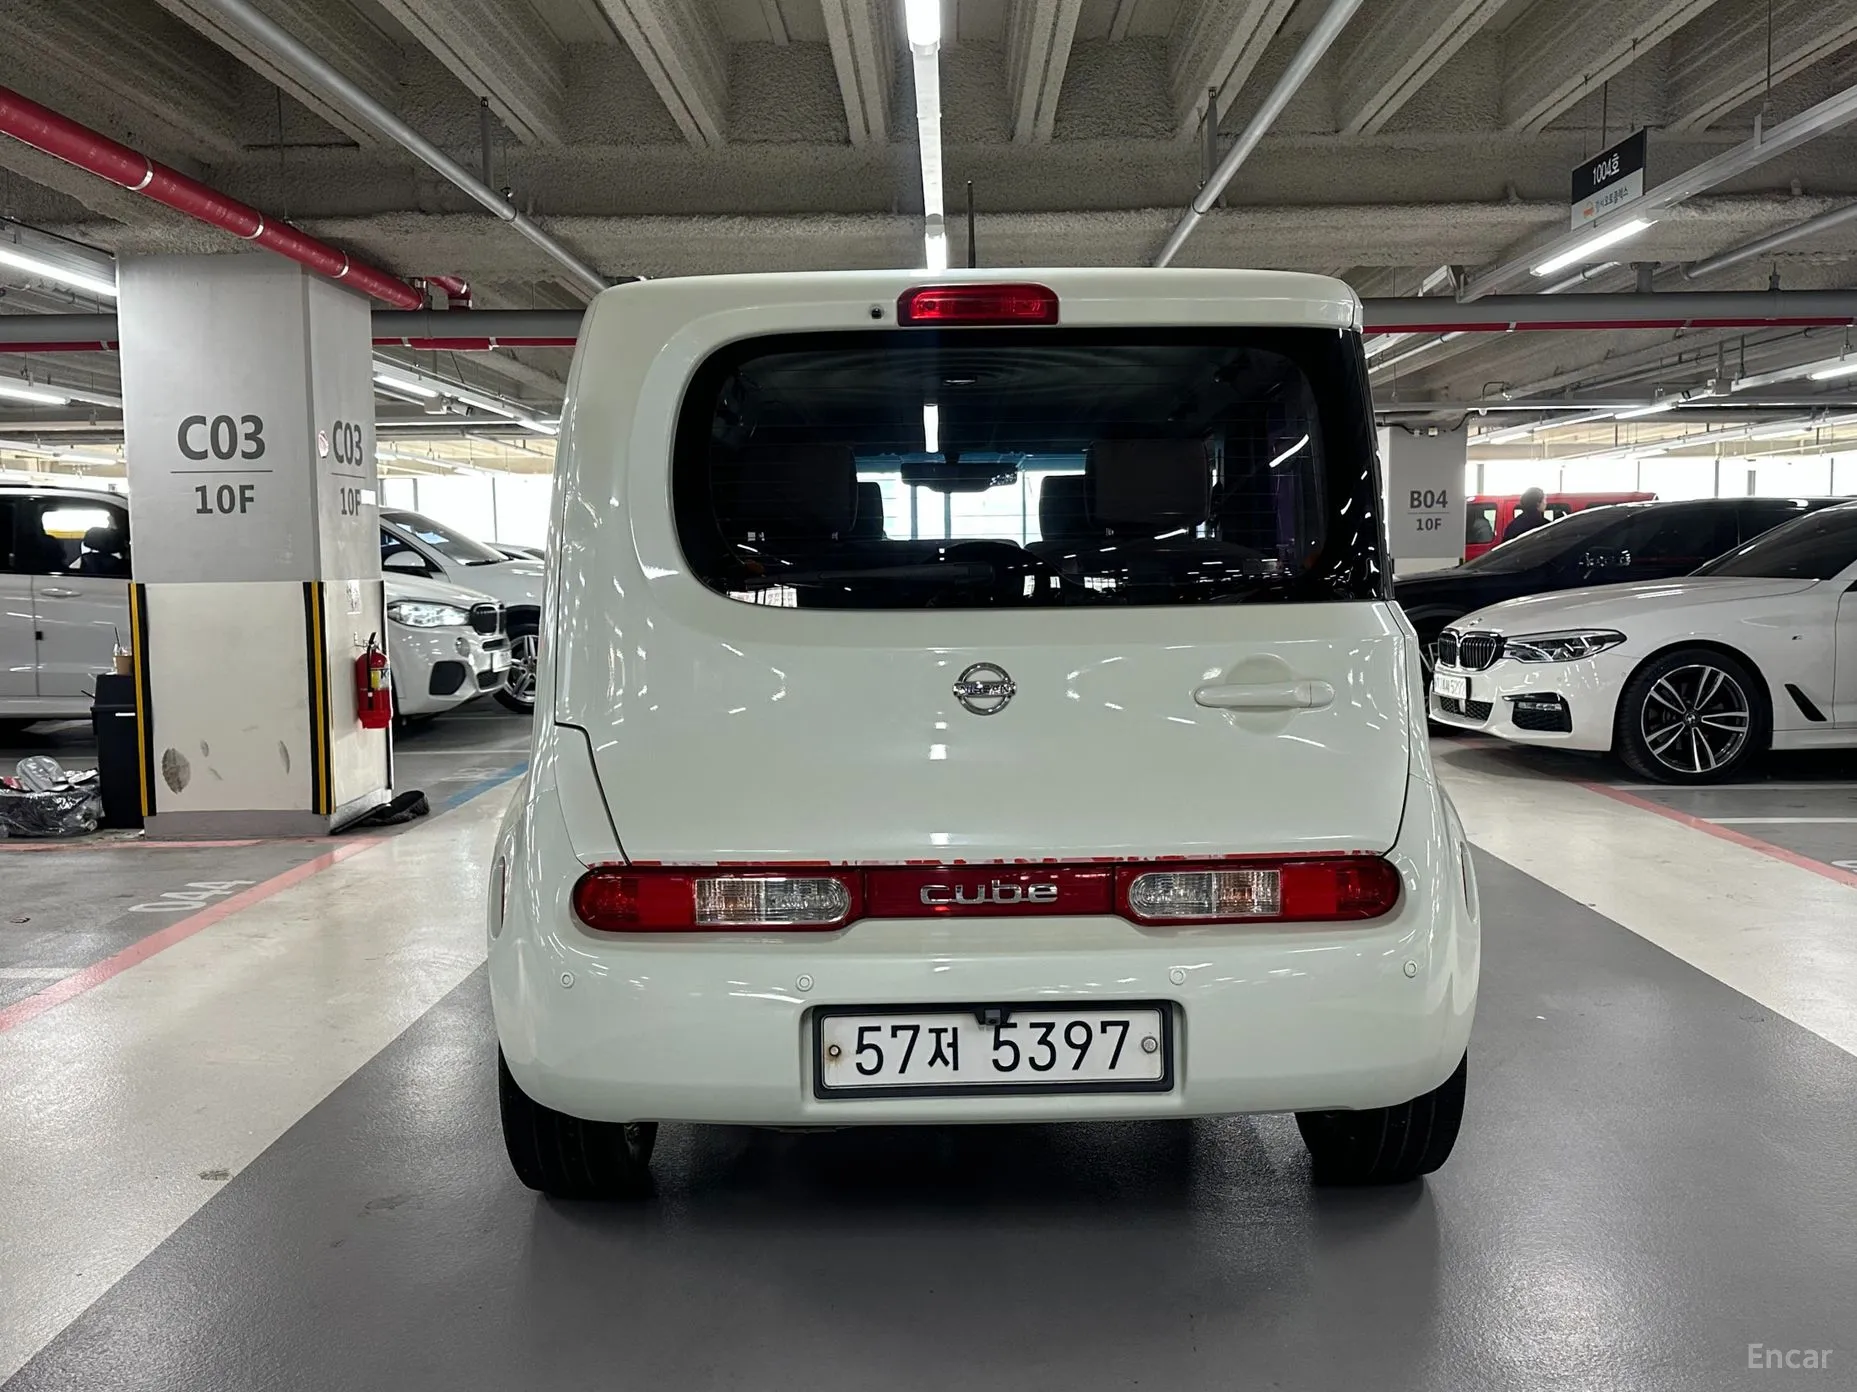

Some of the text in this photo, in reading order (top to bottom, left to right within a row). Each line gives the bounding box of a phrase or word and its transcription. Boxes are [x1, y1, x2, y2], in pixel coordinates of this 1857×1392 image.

[1593, 153, 1620, 185] 1004호
[178, 415, 265, 460] C03
[333, 420, 363, 466] C03
[195, 484, 254, 514] 10F
[1410, 490, 1448, 509] B04
[1416, 518, 1442, 531] 10F
[128, 880, 256, 912] 044
[920, 880, 1058, 904] cube
[855, 1020, 1130, 1076] 57저 5397
